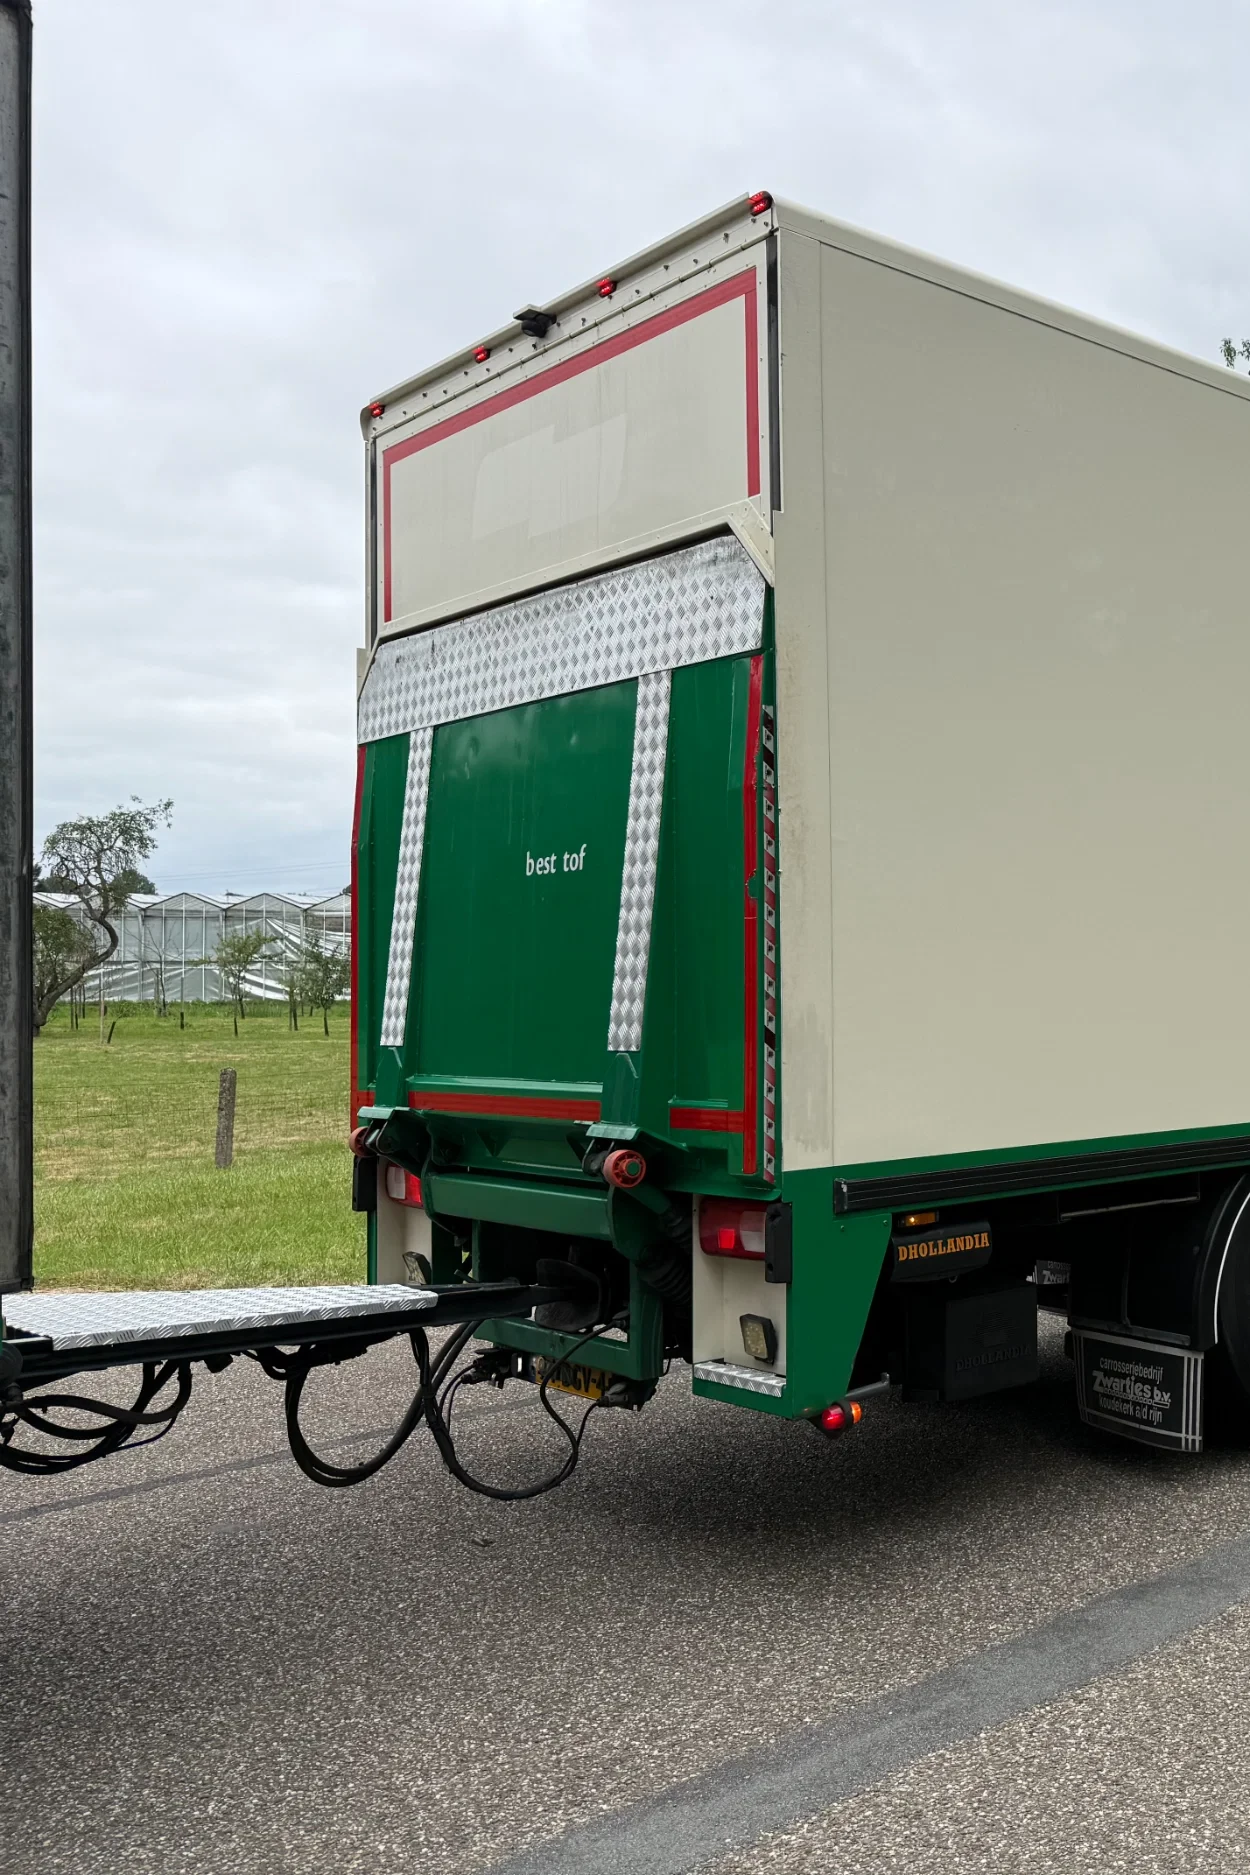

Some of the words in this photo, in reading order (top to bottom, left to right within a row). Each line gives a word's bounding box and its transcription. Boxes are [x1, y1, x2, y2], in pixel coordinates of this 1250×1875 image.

[526, 851, 557, 876] best
[563, 844, 587, 872] tof
[898, 1232, 990, 1262] DHOLLANDIA
[955, 1344, 1032, 1372] DHOLLANDIA
[1099, 1357, 1164, 1385] carrosseriebedrijf
[1092, 1370, 1152, 1400] Zwartjes
[1153, 1386, 1172, 1403] b.v.
[1149, 1407, 1163, 1426] rijn
